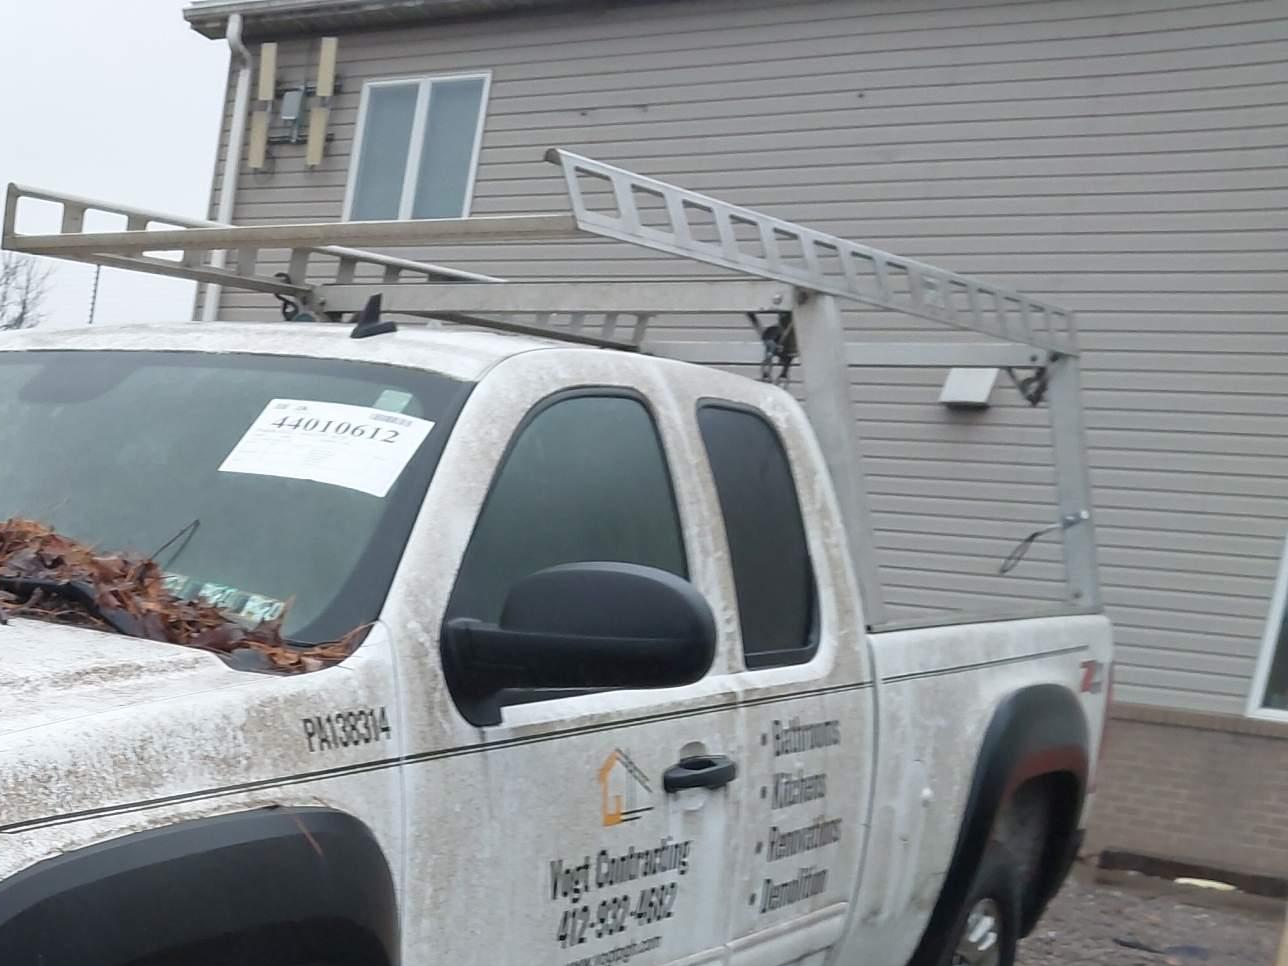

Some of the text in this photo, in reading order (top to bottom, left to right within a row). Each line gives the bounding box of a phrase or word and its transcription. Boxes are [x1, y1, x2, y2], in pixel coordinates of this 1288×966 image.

[272, 416, 400, 443] 44010612
[550, 837, 692, 903] Vogt Contracting
